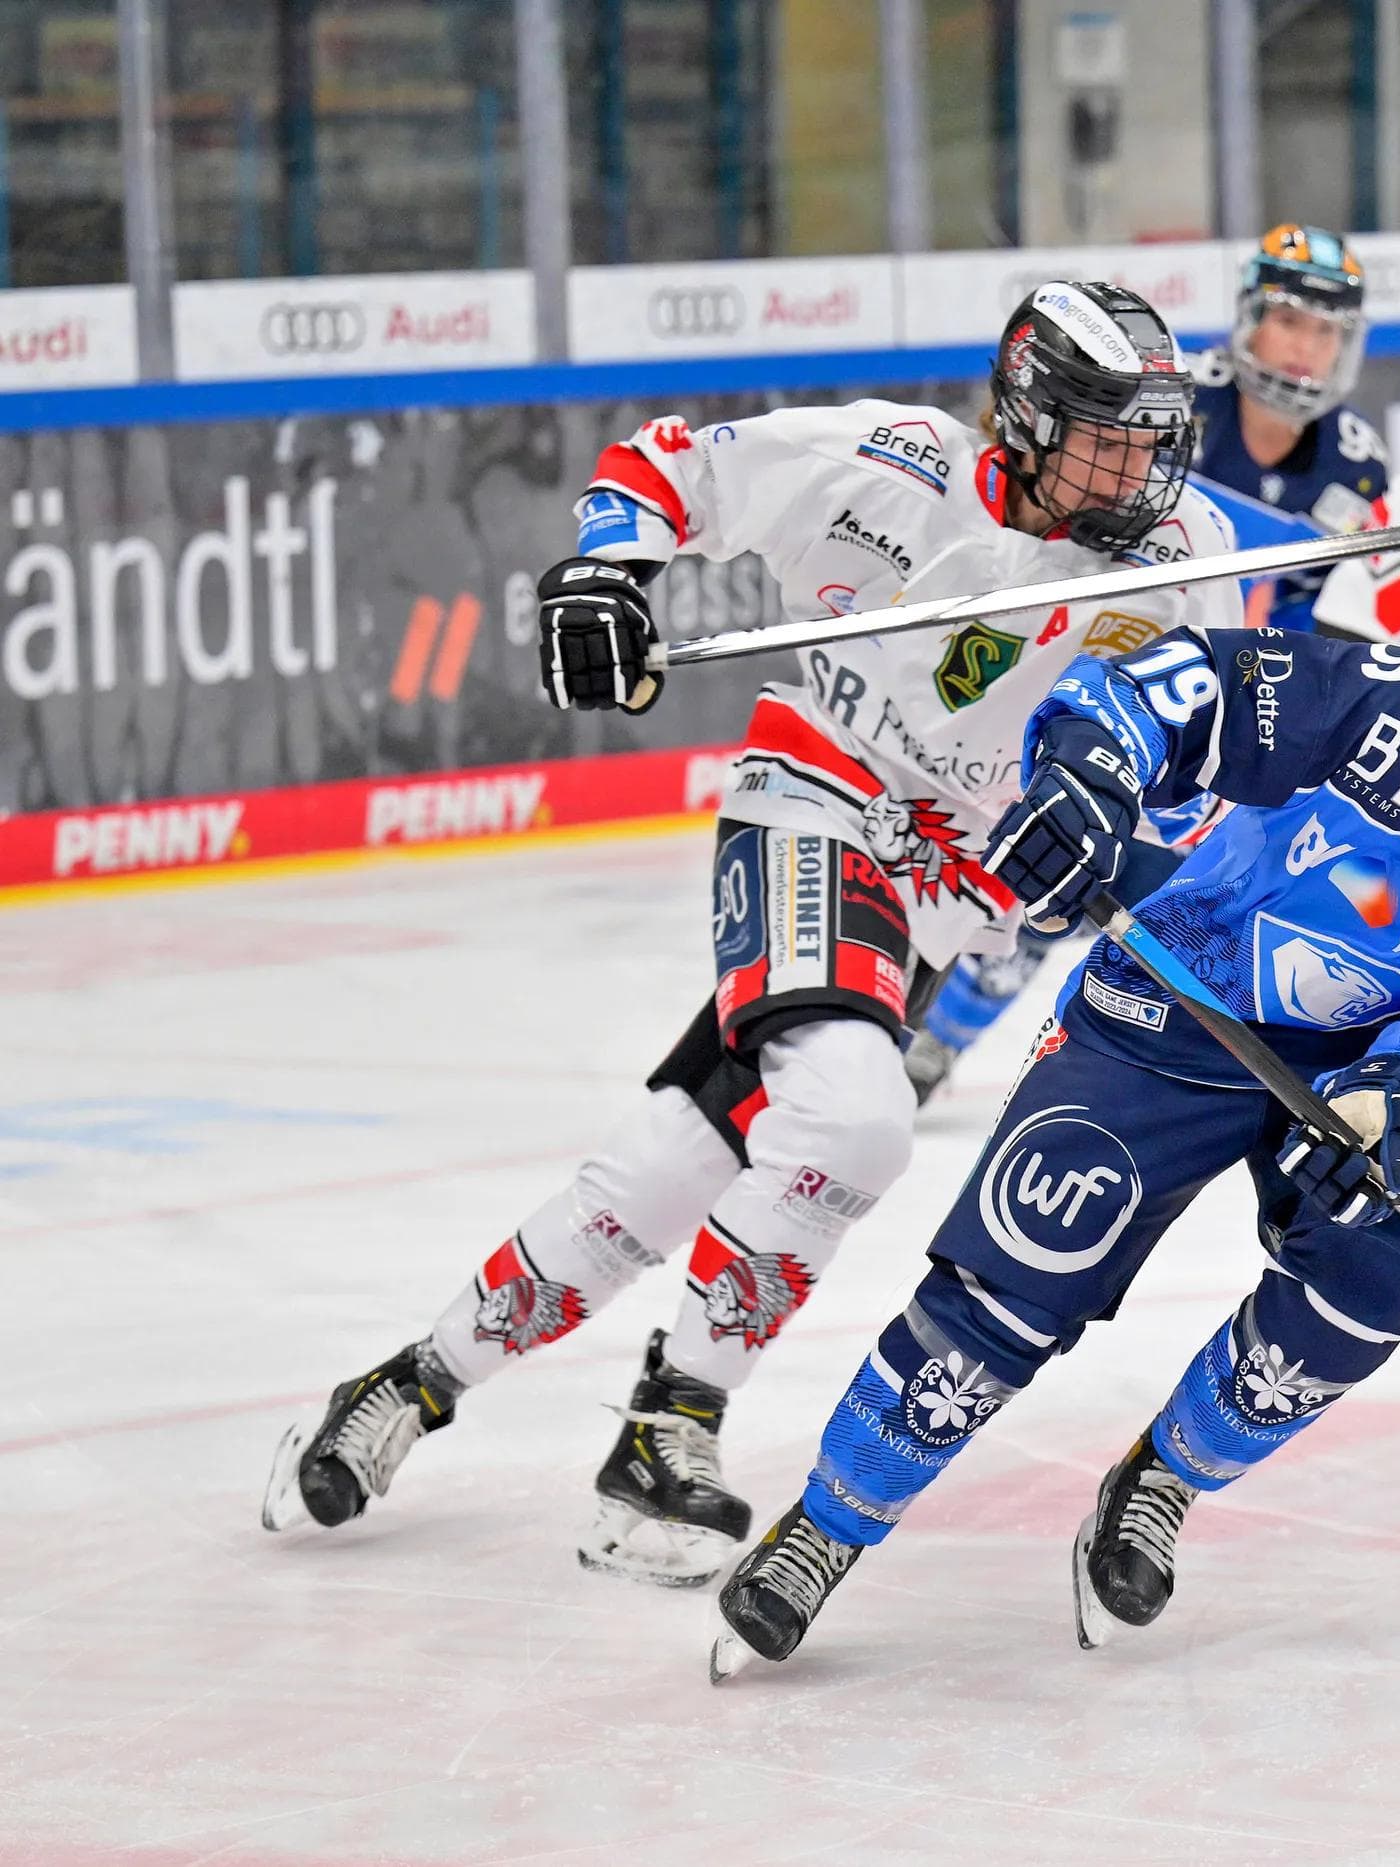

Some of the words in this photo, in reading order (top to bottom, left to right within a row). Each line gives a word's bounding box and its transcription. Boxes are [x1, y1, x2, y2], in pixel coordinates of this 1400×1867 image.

[384, 304, 490, 346] Audi
[762, 287, 860, 328] Audi
[870, 426, 950, 480] BreFa
[831, 509, 912, 572] Jäckle
[1256, 647, 1294, 752] Detter
[1336, 768, 1400, 819] YSTEMS
[796, 834, 823, 962] BOHNET
